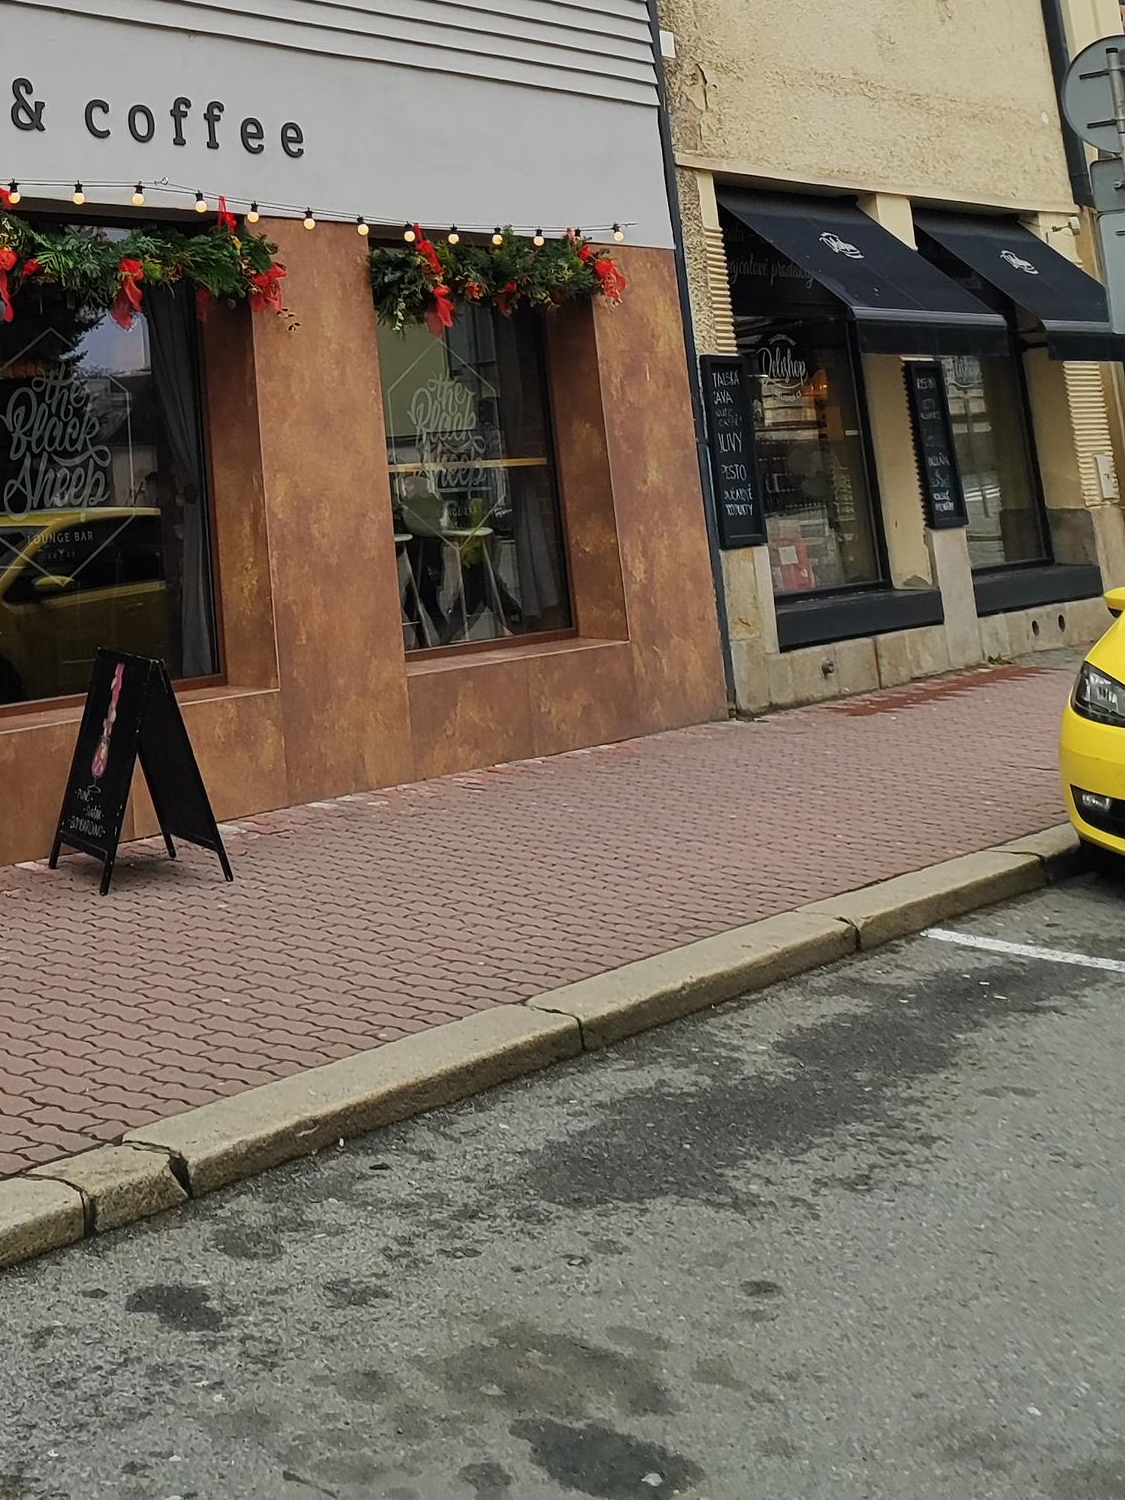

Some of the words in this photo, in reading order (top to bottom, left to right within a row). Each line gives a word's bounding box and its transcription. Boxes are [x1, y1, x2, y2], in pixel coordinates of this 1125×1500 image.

[10, 77, 46, 132] &
[85, 97, 304, 158] coffee
[0, 388, 111, 466] Black
[407, 388, 486, 453] Black
[427, 373, 474, 415] the
[4, 452, 111, 522] Sheep
[27, 532, 70, 544] LOUNGE
[74, 531, 94, 542] BAR
